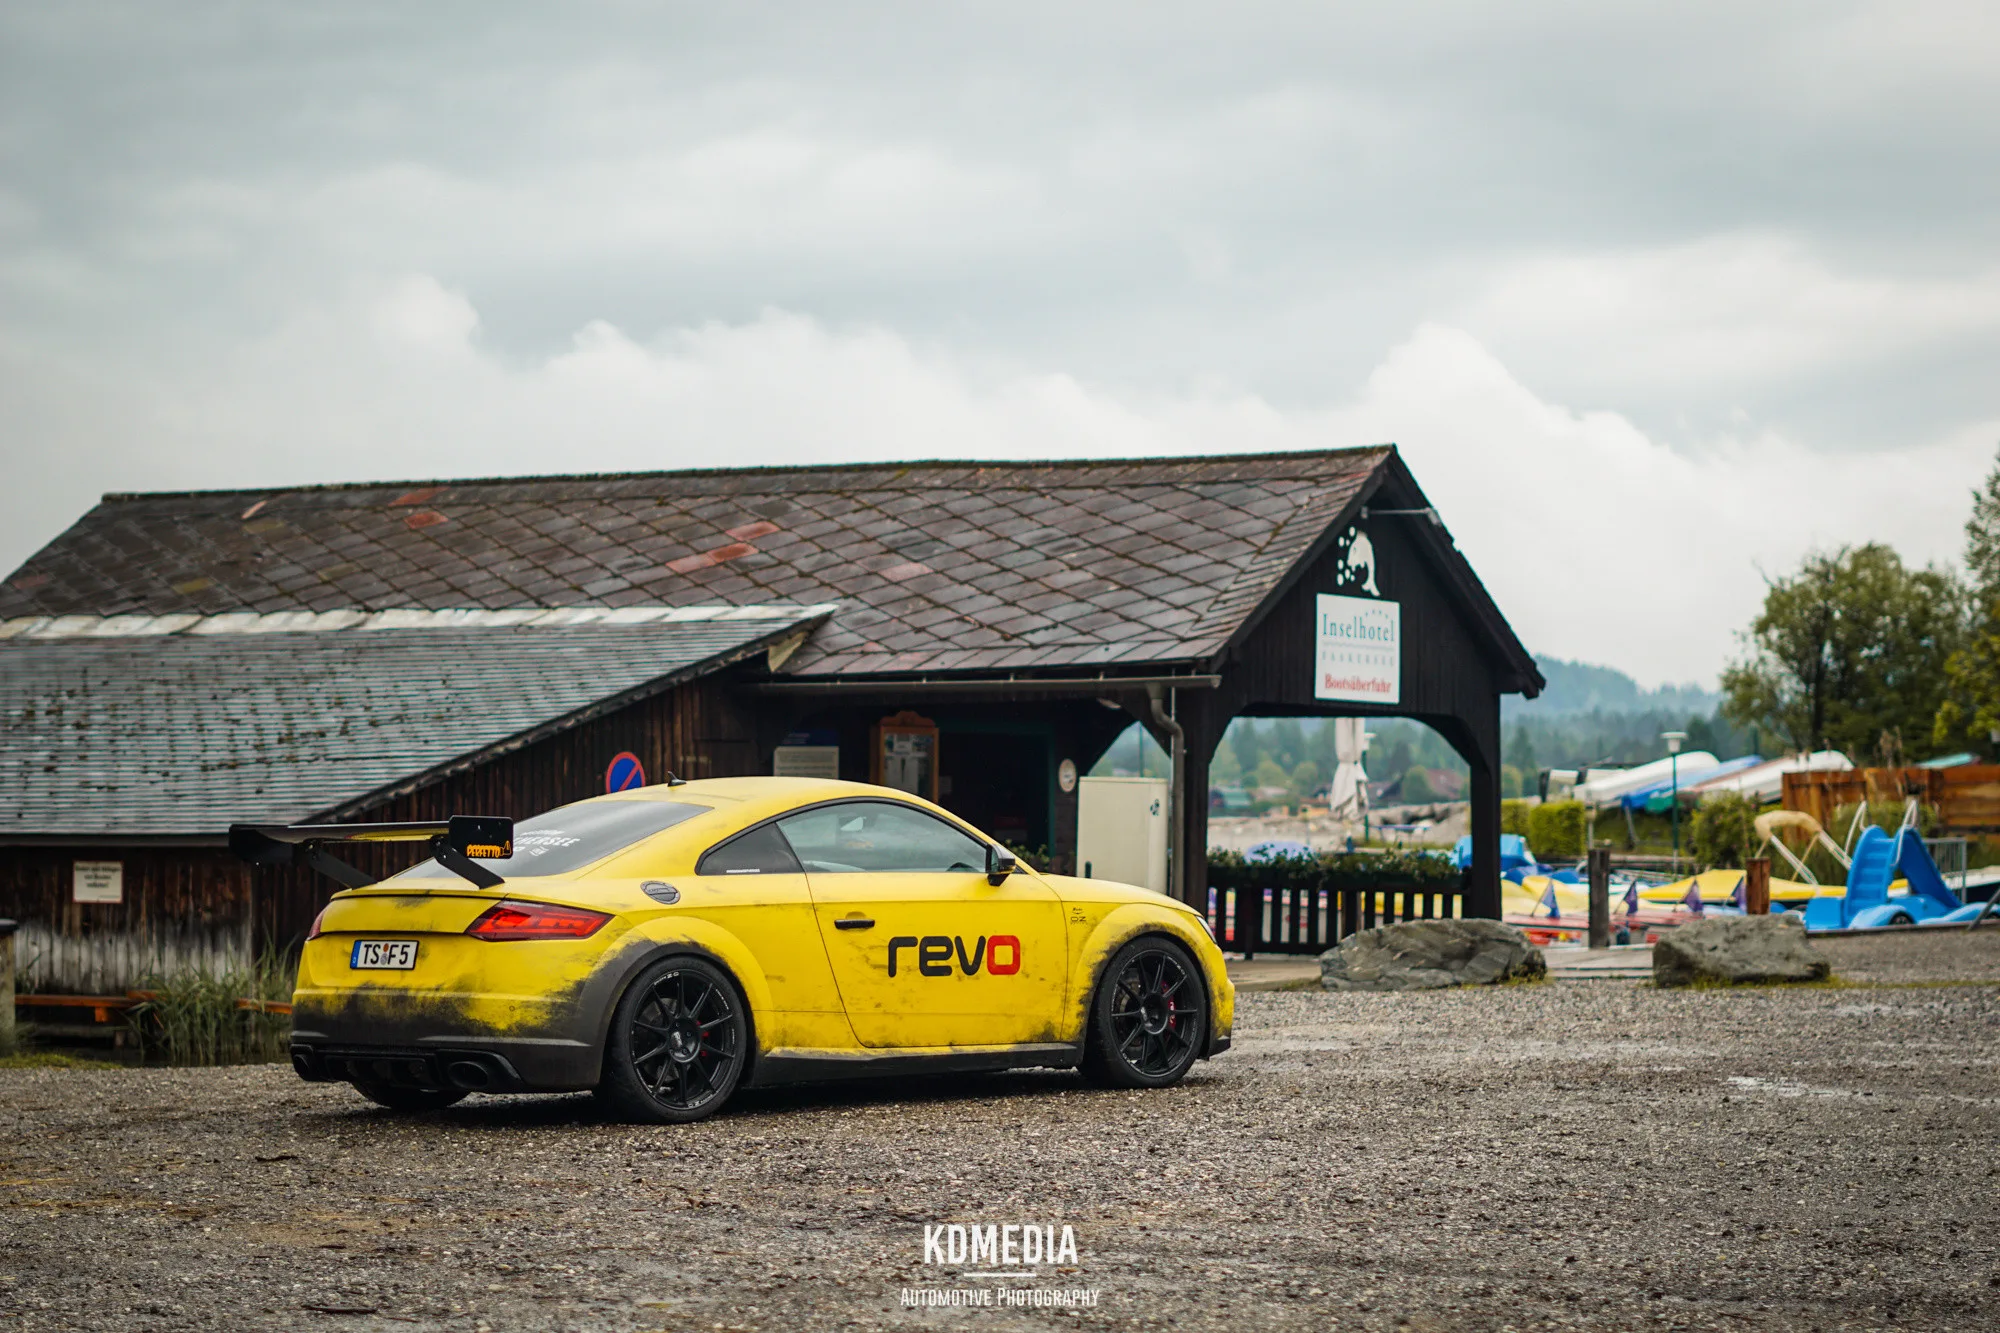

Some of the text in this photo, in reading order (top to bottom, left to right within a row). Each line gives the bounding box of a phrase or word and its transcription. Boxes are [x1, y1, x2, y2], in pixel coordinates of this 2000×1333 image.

[1323, 613, 1394, 642] Inselhotel
[466, 844, 501, 858] PERFETTO
[364, 944, 381, 965] TS
[888, 935, 1021, 978] revo
